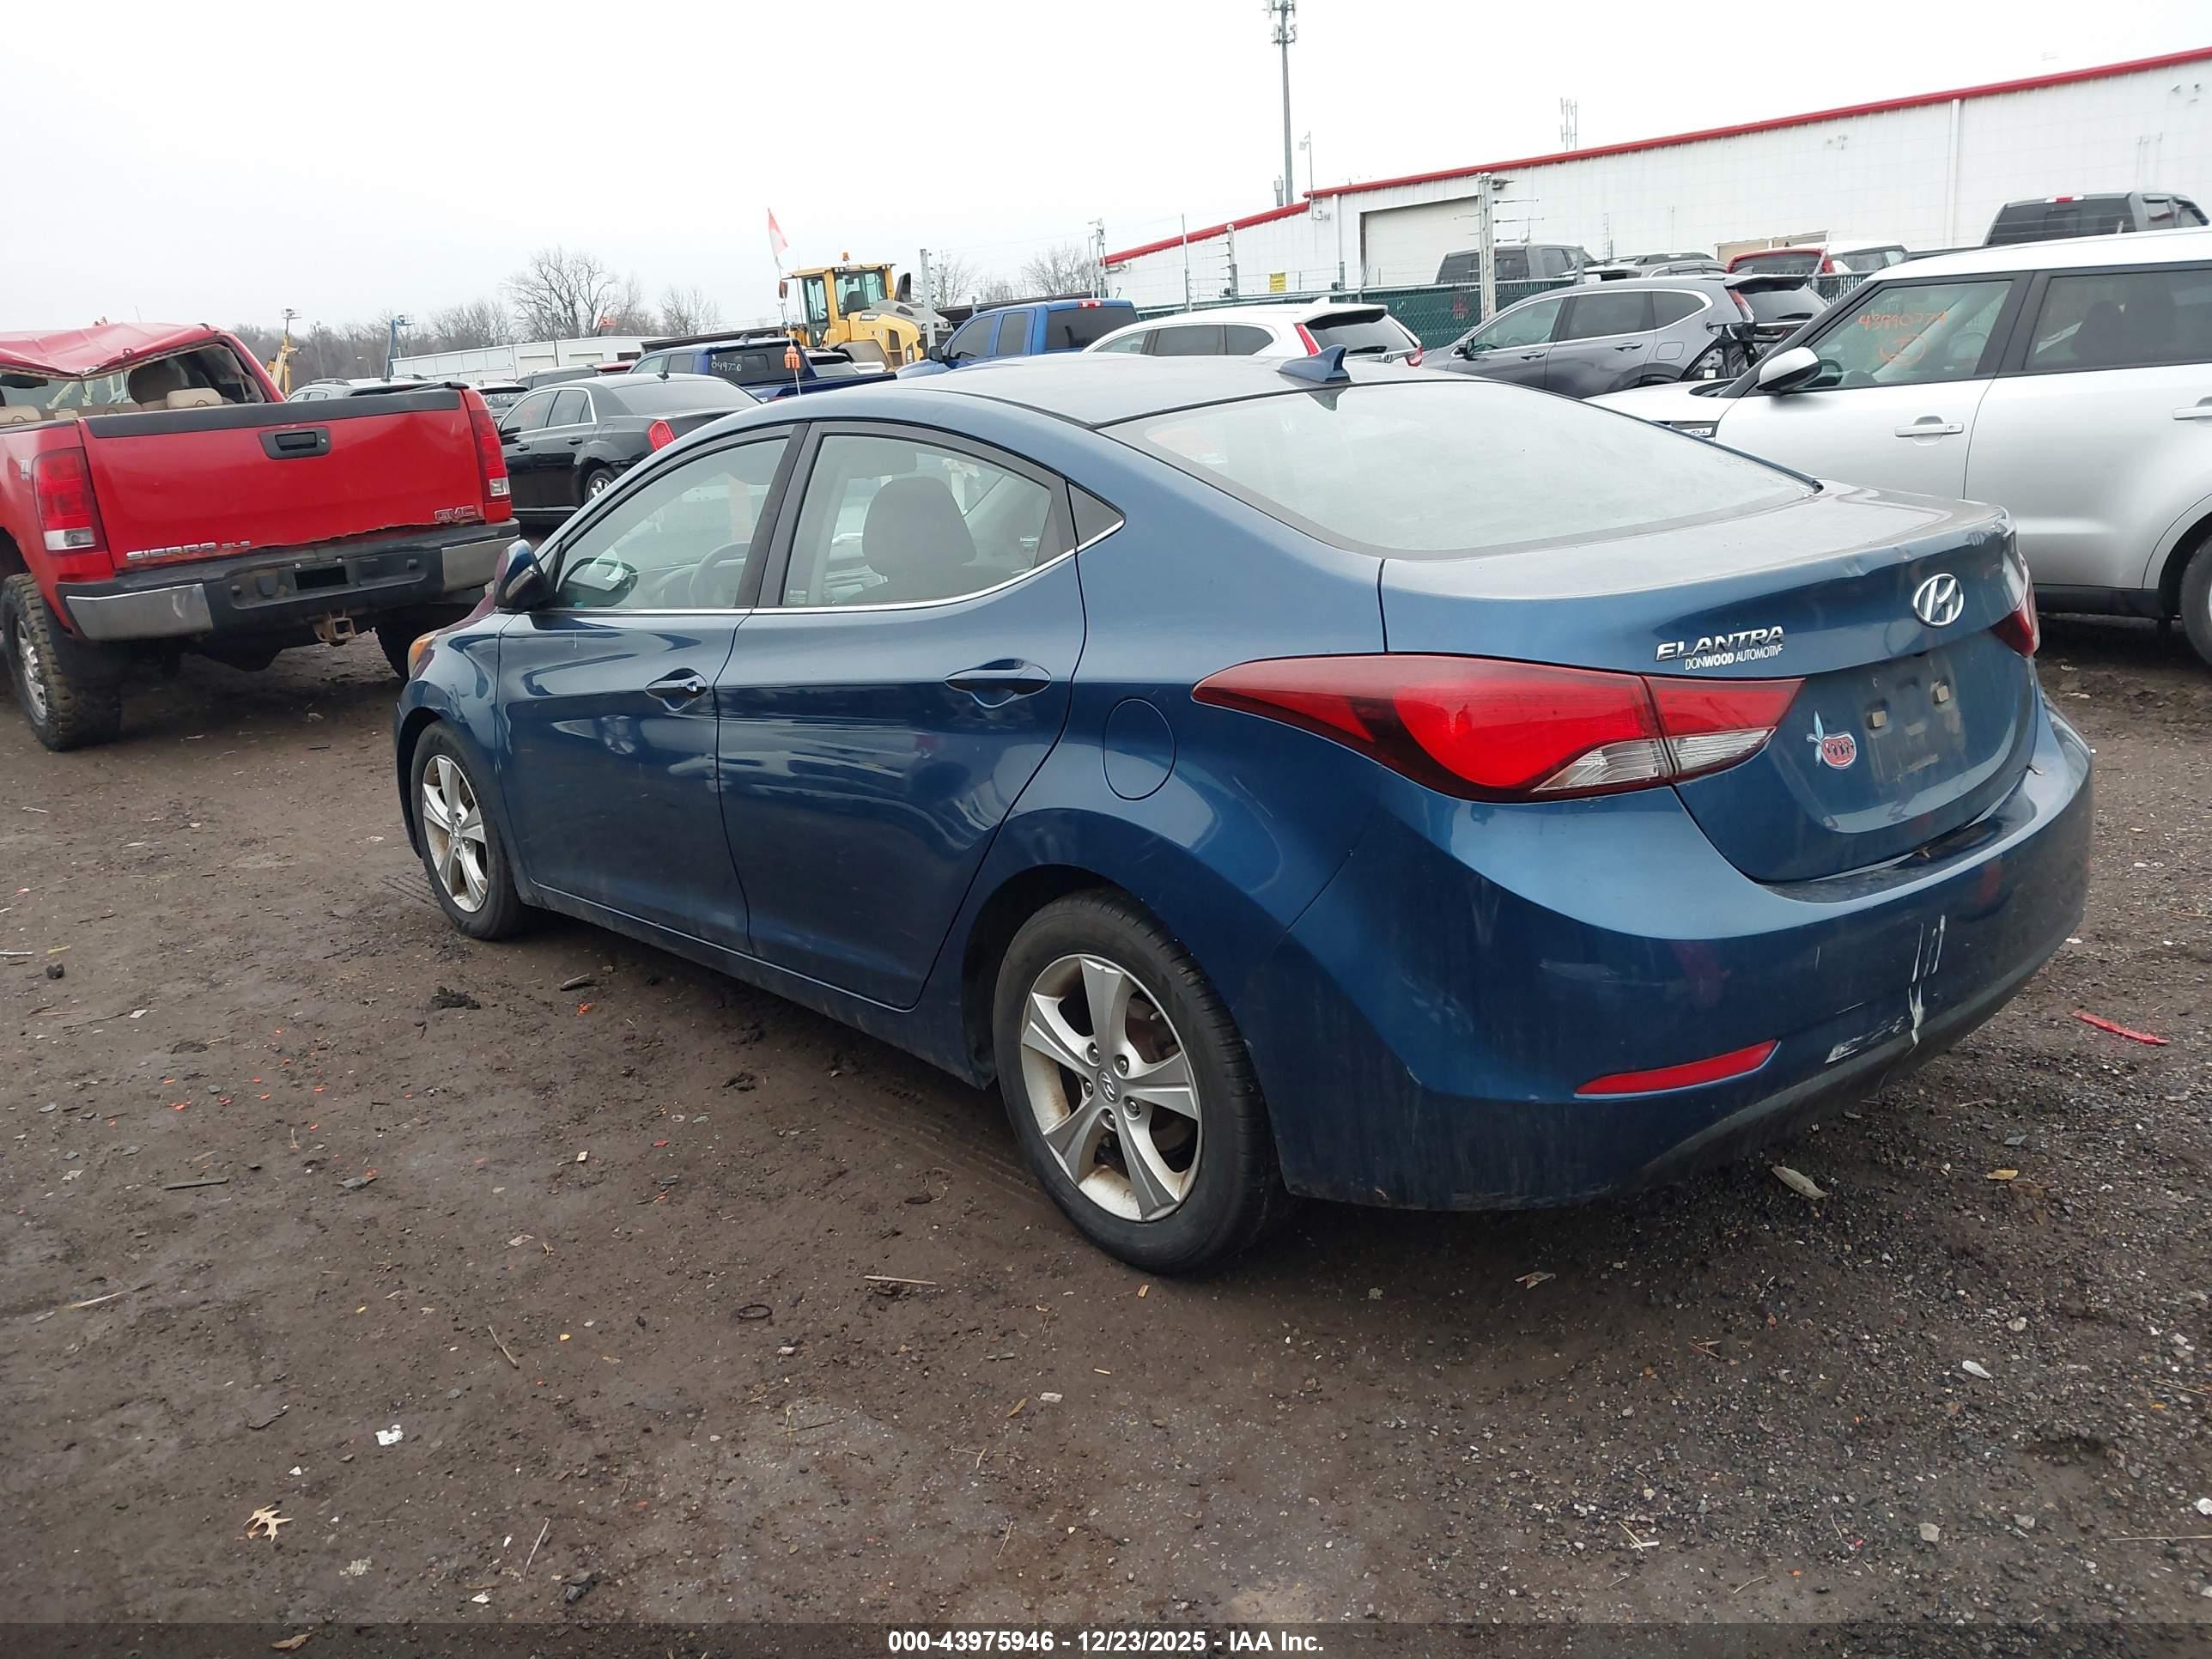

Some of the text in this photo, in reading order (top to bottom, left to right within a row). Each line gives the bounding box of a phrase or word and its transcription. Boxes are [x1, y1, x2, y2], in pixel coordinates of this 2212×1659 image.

[434, 505, 477, 523] GMC
[126, 541, 216, 560] SIERRA
[1656, 625, 1785, 661] ELANTRA
[1684, 653, 1735, 671] DONWOOD
